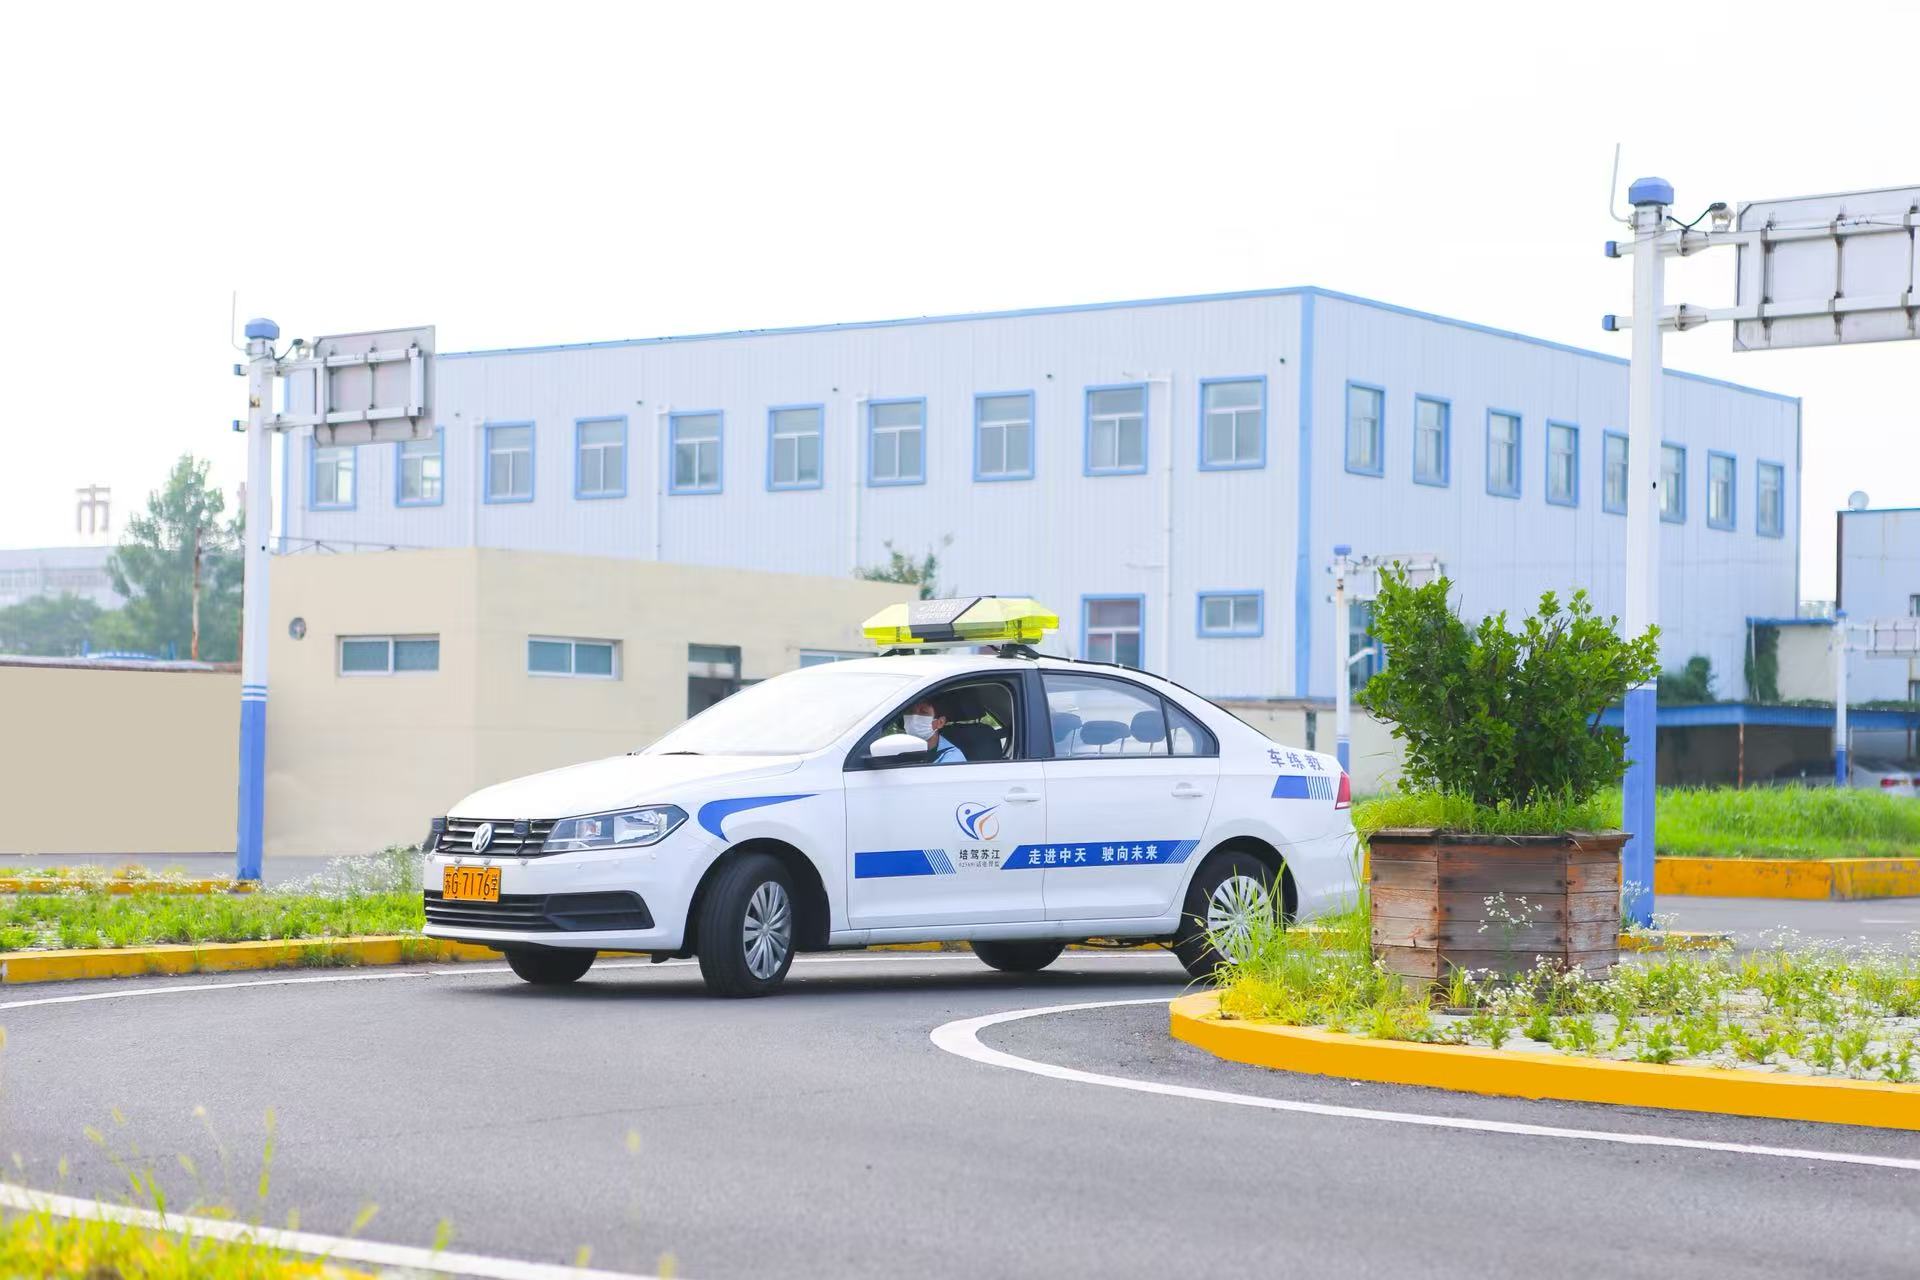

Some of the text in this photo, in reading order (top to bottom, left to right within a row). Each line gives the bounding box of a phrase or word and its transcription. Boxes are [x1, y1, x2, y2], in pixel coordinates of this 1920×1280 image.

[1028, 844, 1158, 865] 走进中天 驶向未来
